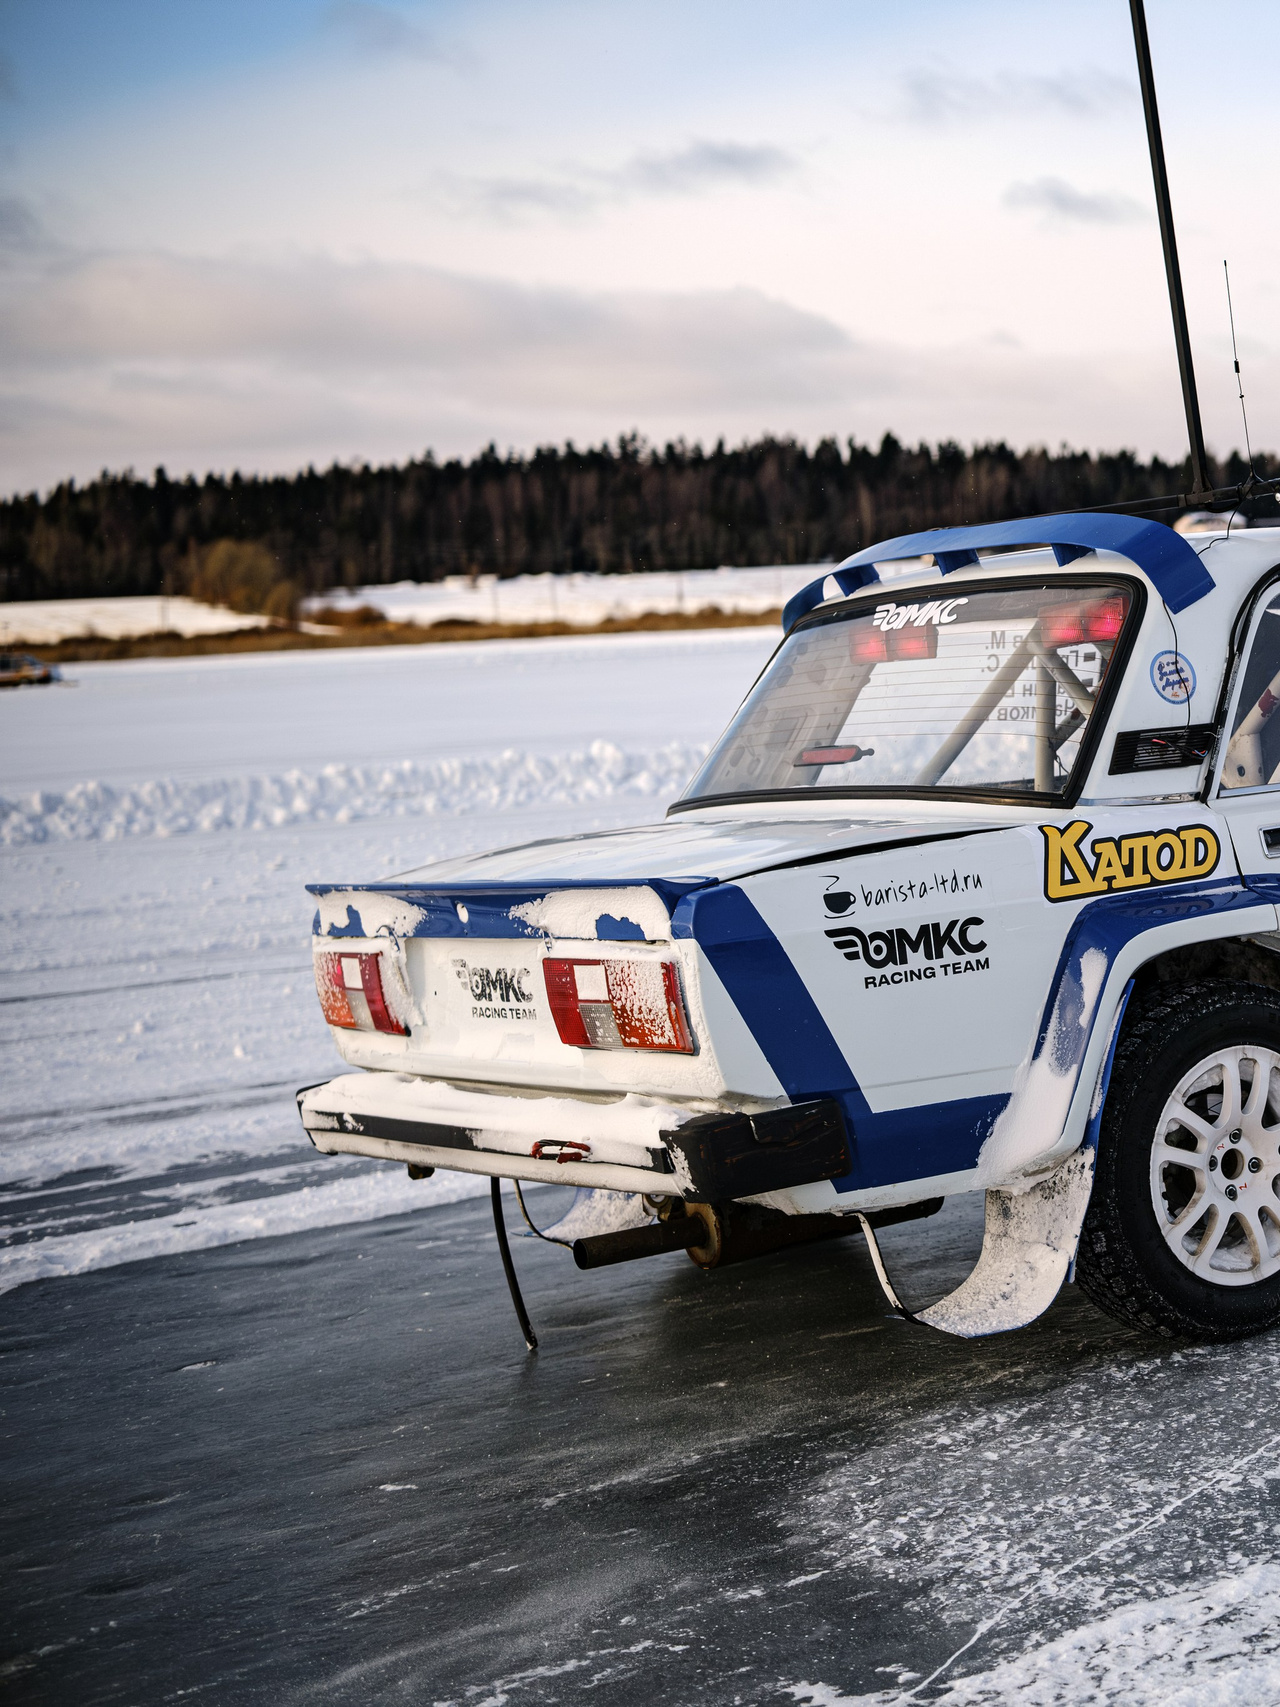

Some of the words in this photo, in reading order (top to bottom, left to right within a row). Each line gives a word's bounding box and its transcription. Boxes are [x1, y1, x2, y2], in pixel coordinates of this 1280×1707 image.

[1038, 820, 1221, 903] KATOD
[861, 869, 983, 907] barista-ltd.ru
[864, 966, 937, 989] RACING
[940, 957, 990, 977] TEAM
[472, 1006, 507, 1019] RACING
[509, 1008, 537, 1020] TEAM
